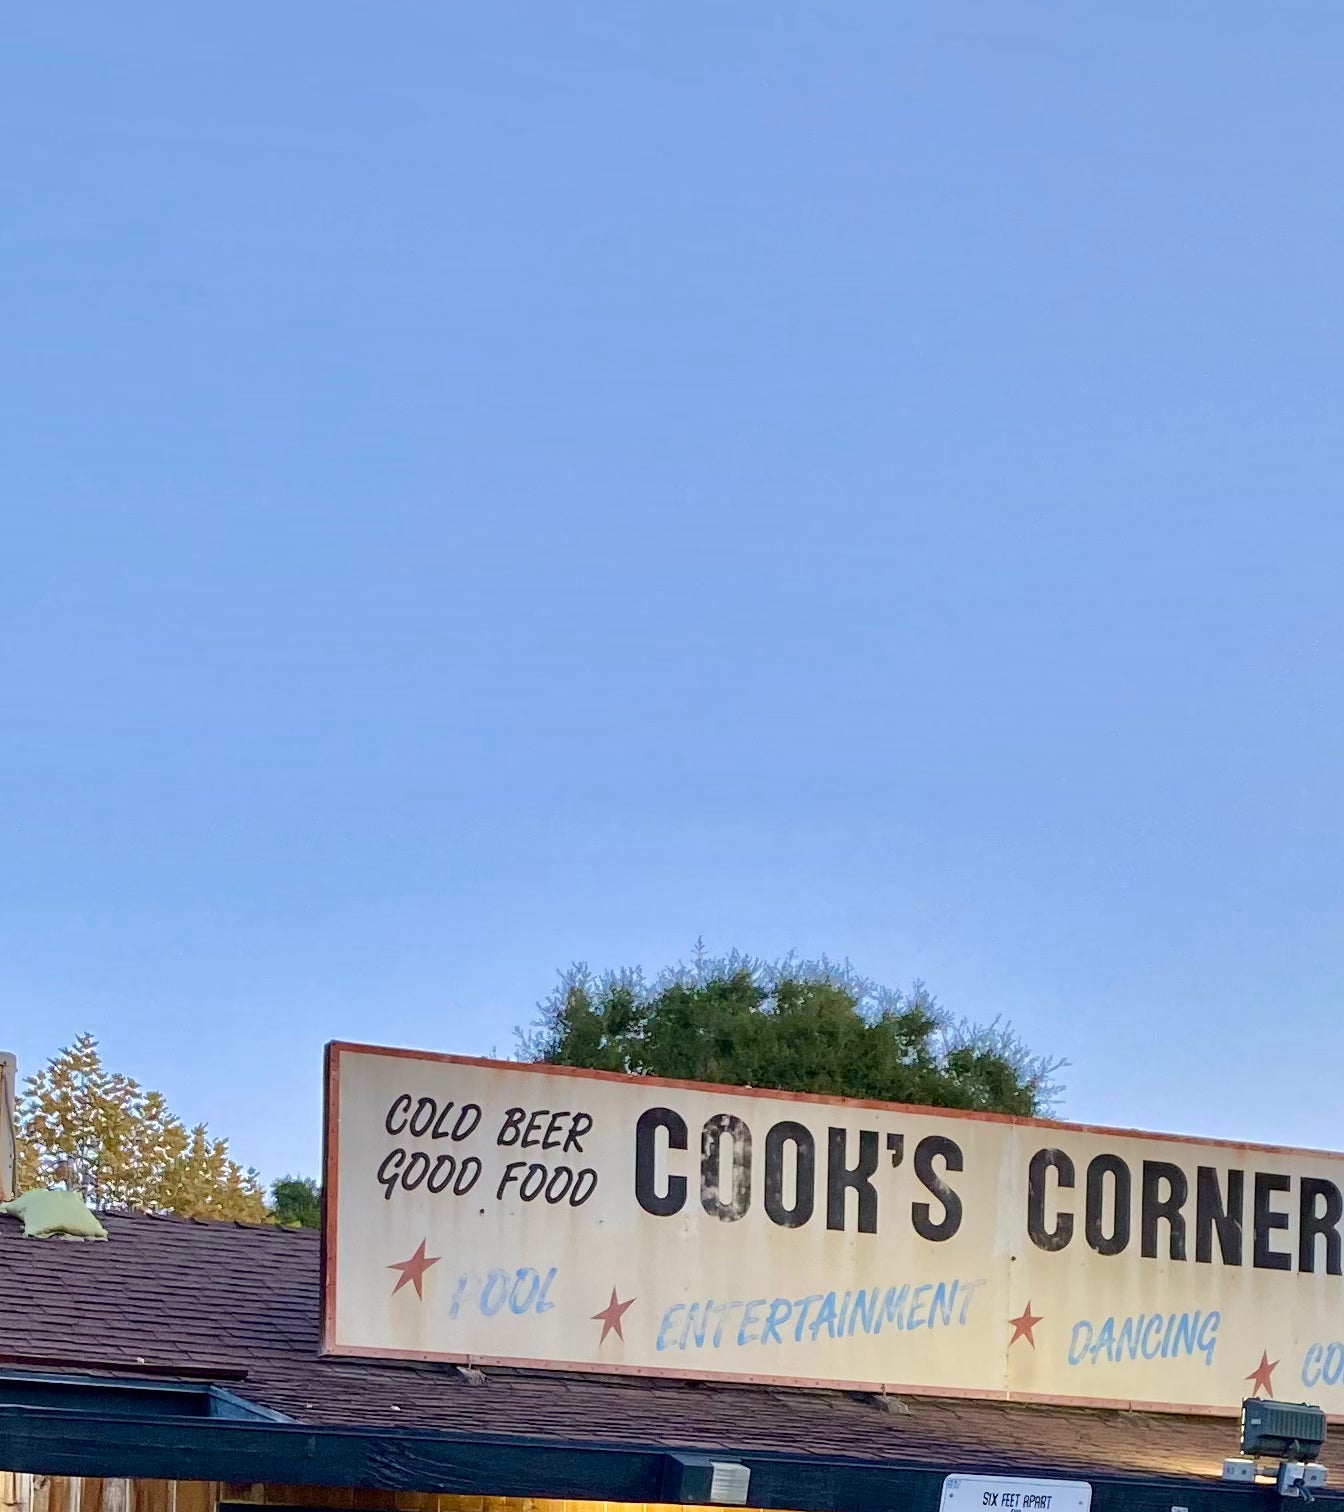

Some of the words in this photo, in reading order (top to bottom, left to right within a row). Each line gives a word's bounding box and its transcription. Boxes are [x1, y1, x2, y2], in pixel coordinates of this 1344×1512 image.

[385, 1094, 483, 1141] COLD
[497, 1107, 594, 1153] BEER
[377, 1147, 482, 1199] GOOD
[496, 1162, 598, 1208] FOOD
[635, 1106, 964, 1242] COOK'S
[1026, 1147, 1343, 1275] CORNER
[656, 1278, 987, 1351] ENTERTAINMENT
[1068, 1310, 1221, 1366] DANCING
[982, 1491, 999, 1507] SIX
[1001, 1493, 1021, 1508] FEET
[1023, 1495, 1052, 1510] APART
